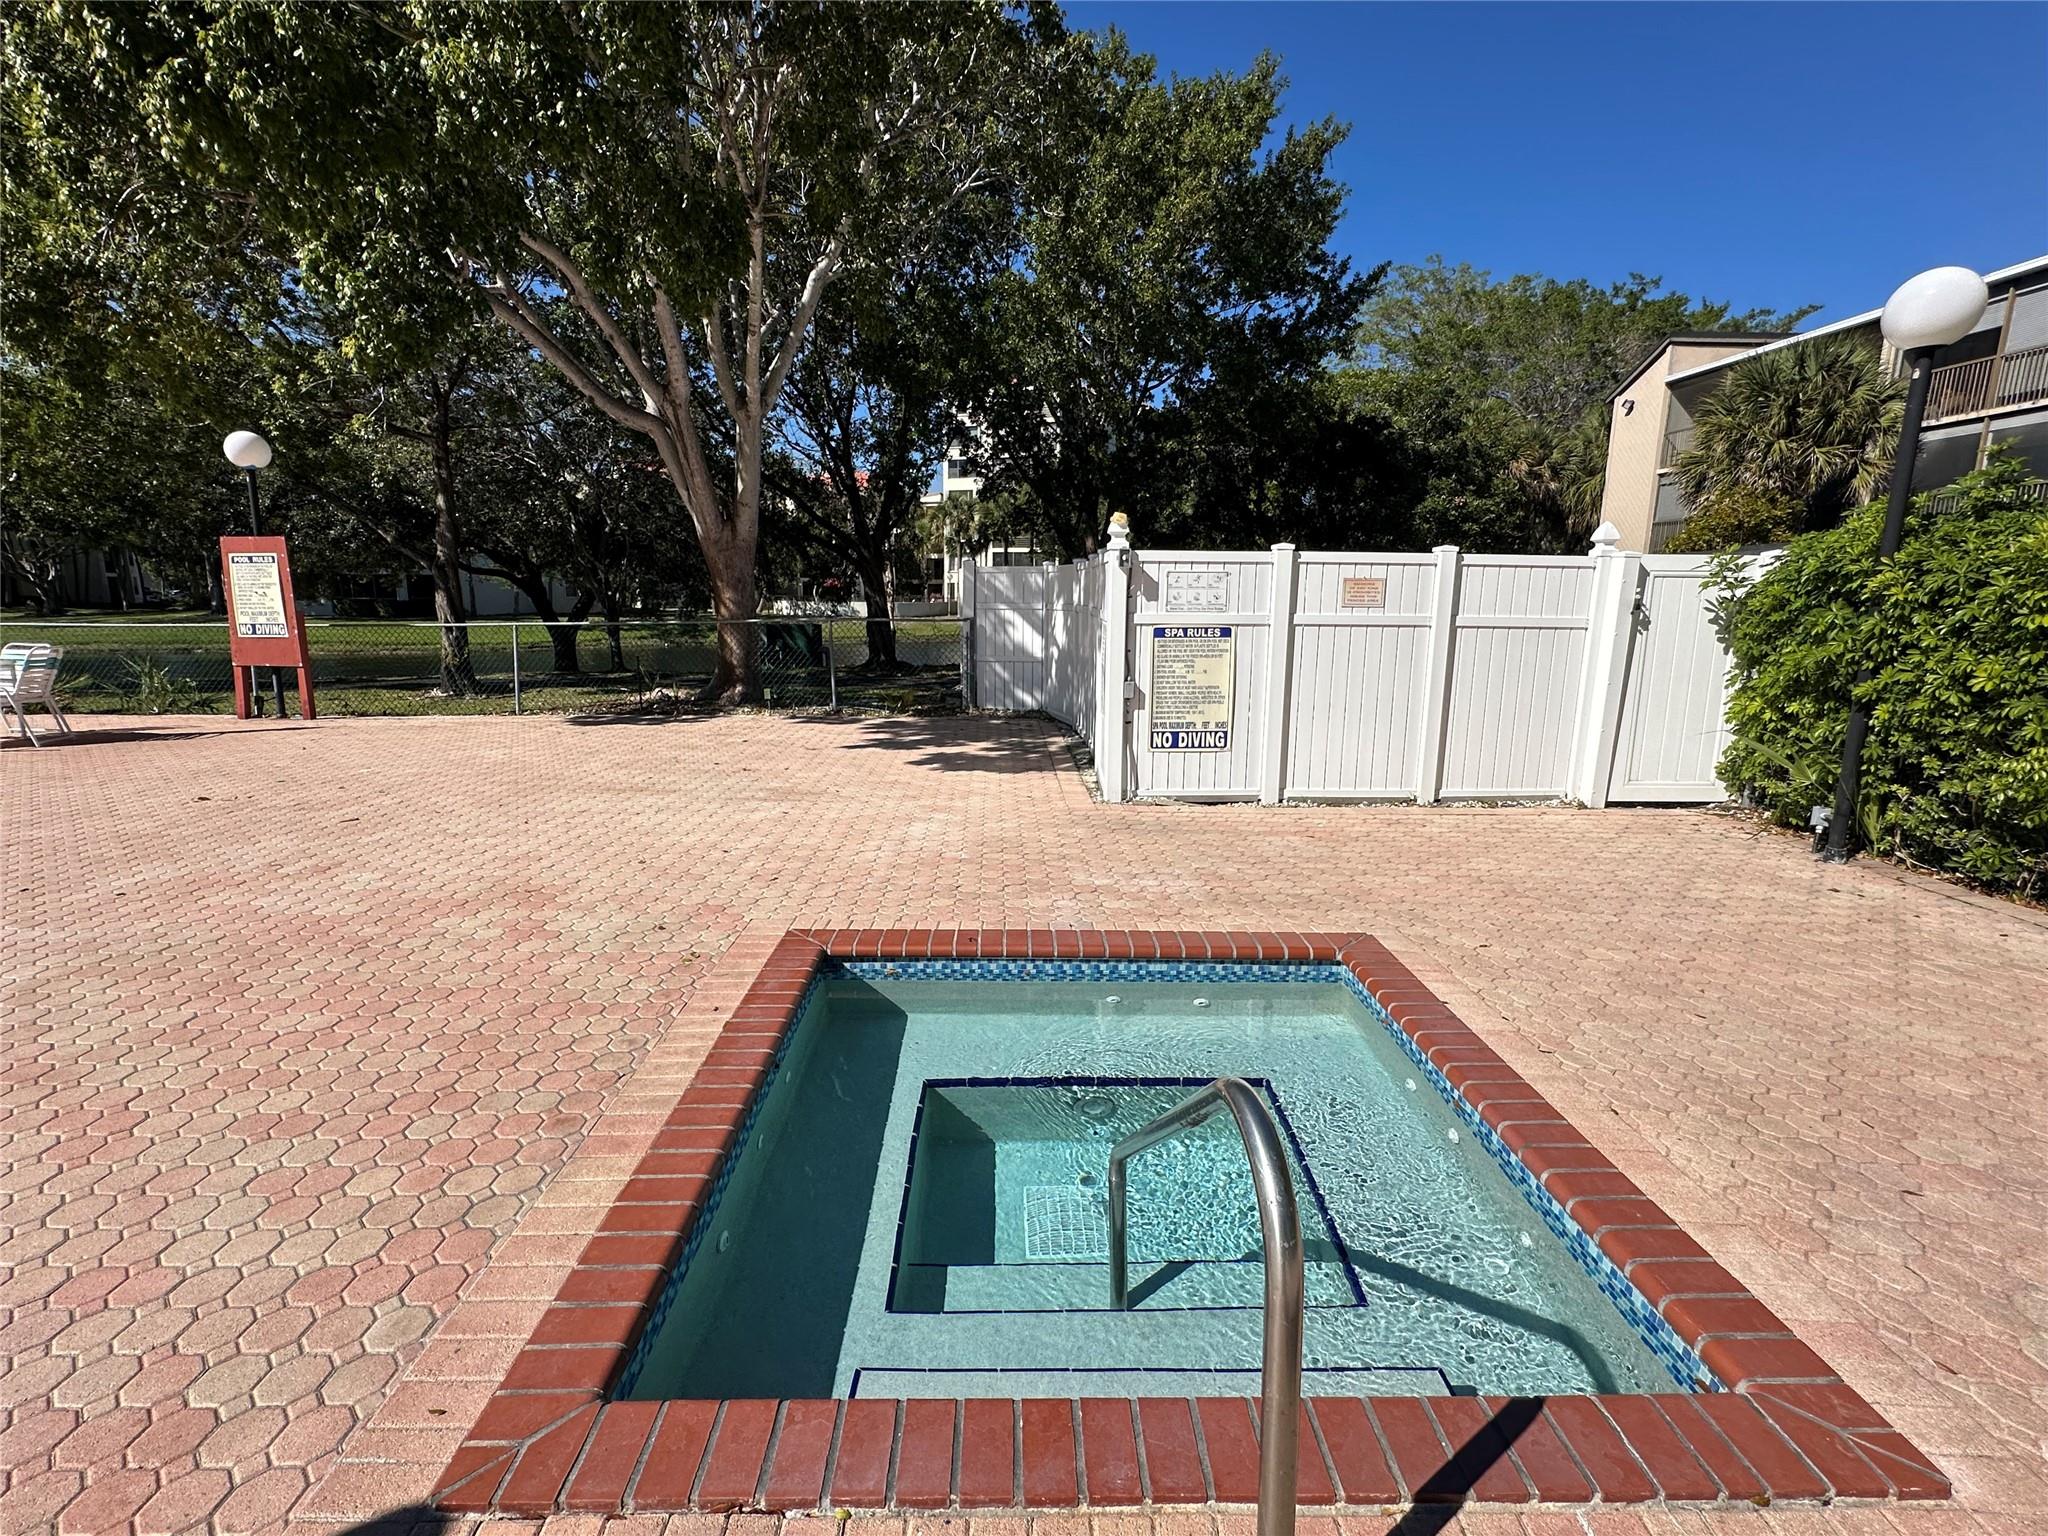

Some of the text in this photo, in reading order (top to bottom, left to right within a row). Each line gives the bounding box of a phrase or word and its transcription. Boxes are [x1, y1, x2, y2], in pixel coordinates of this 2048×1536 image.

[239, 624, 286, 635] NO DIVING
[1164, 628, 1221, 637] SPA RULES
[1152, 731, 1226, 748] NO DIVING
